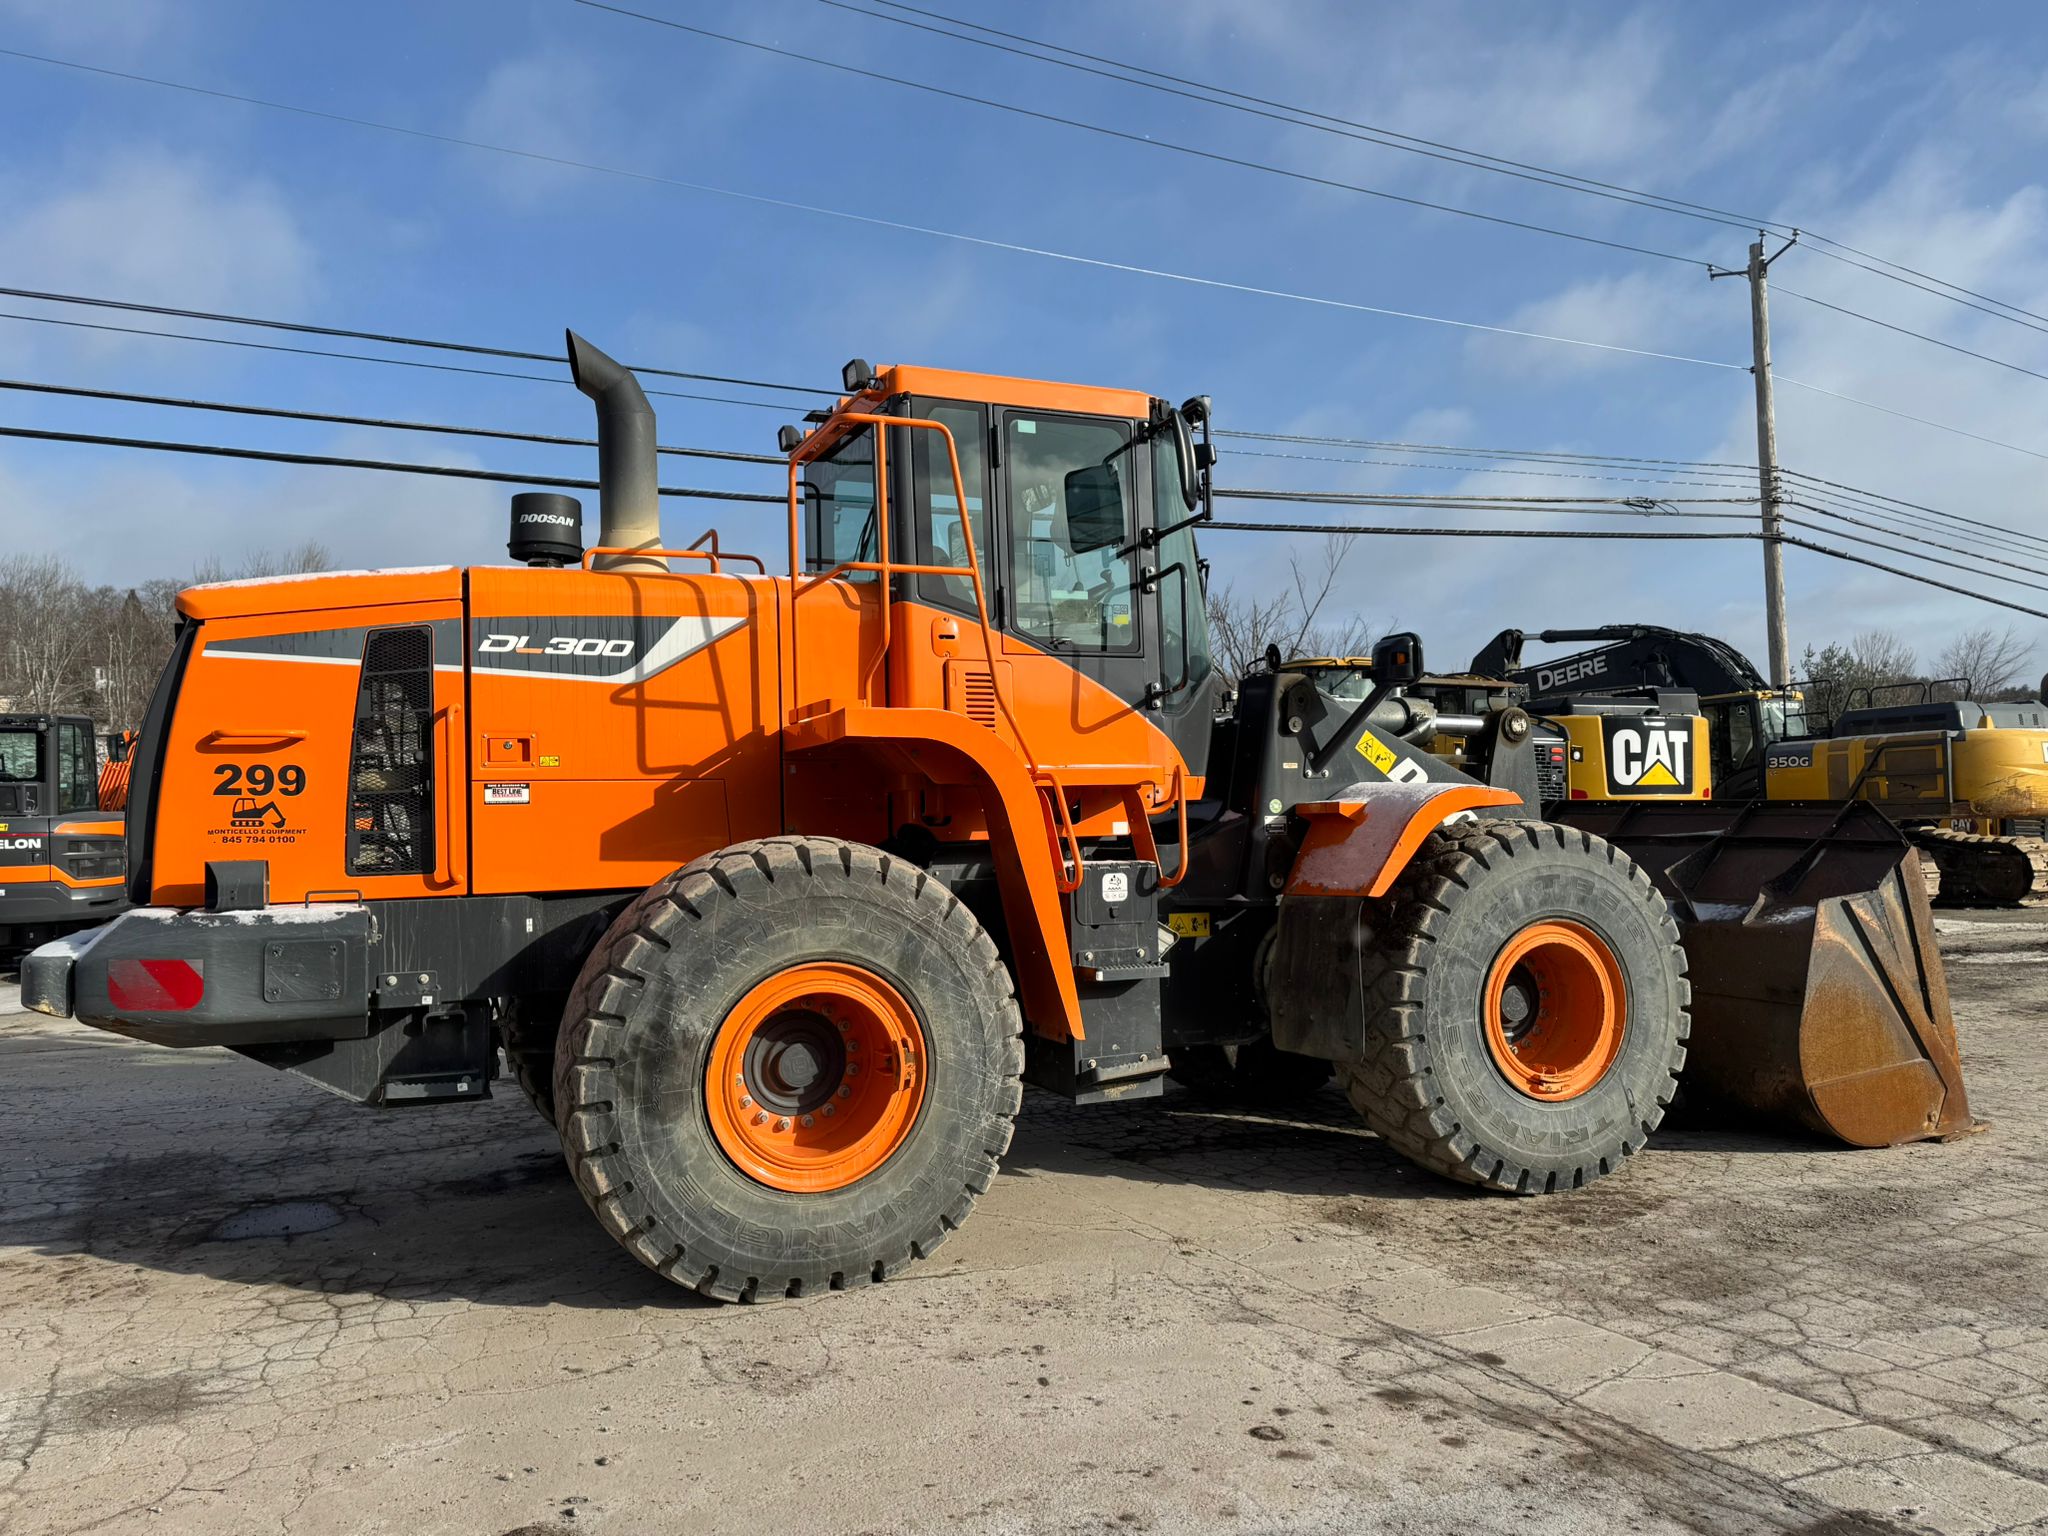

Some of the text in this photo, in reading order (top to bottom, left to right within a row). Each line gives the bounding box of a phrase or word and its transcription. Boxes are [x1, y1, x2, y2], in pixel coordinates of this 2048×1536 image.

[520, 513, 574, 527] DOOSAN
[478, 634, 635, 656] DL300
[1537, 655, 1608, 691] DEERE
[1612, 729, 1688, 786] CAT
[1769, 756, 1809, 768] 350G
[213, 764, 306, 796] 299
